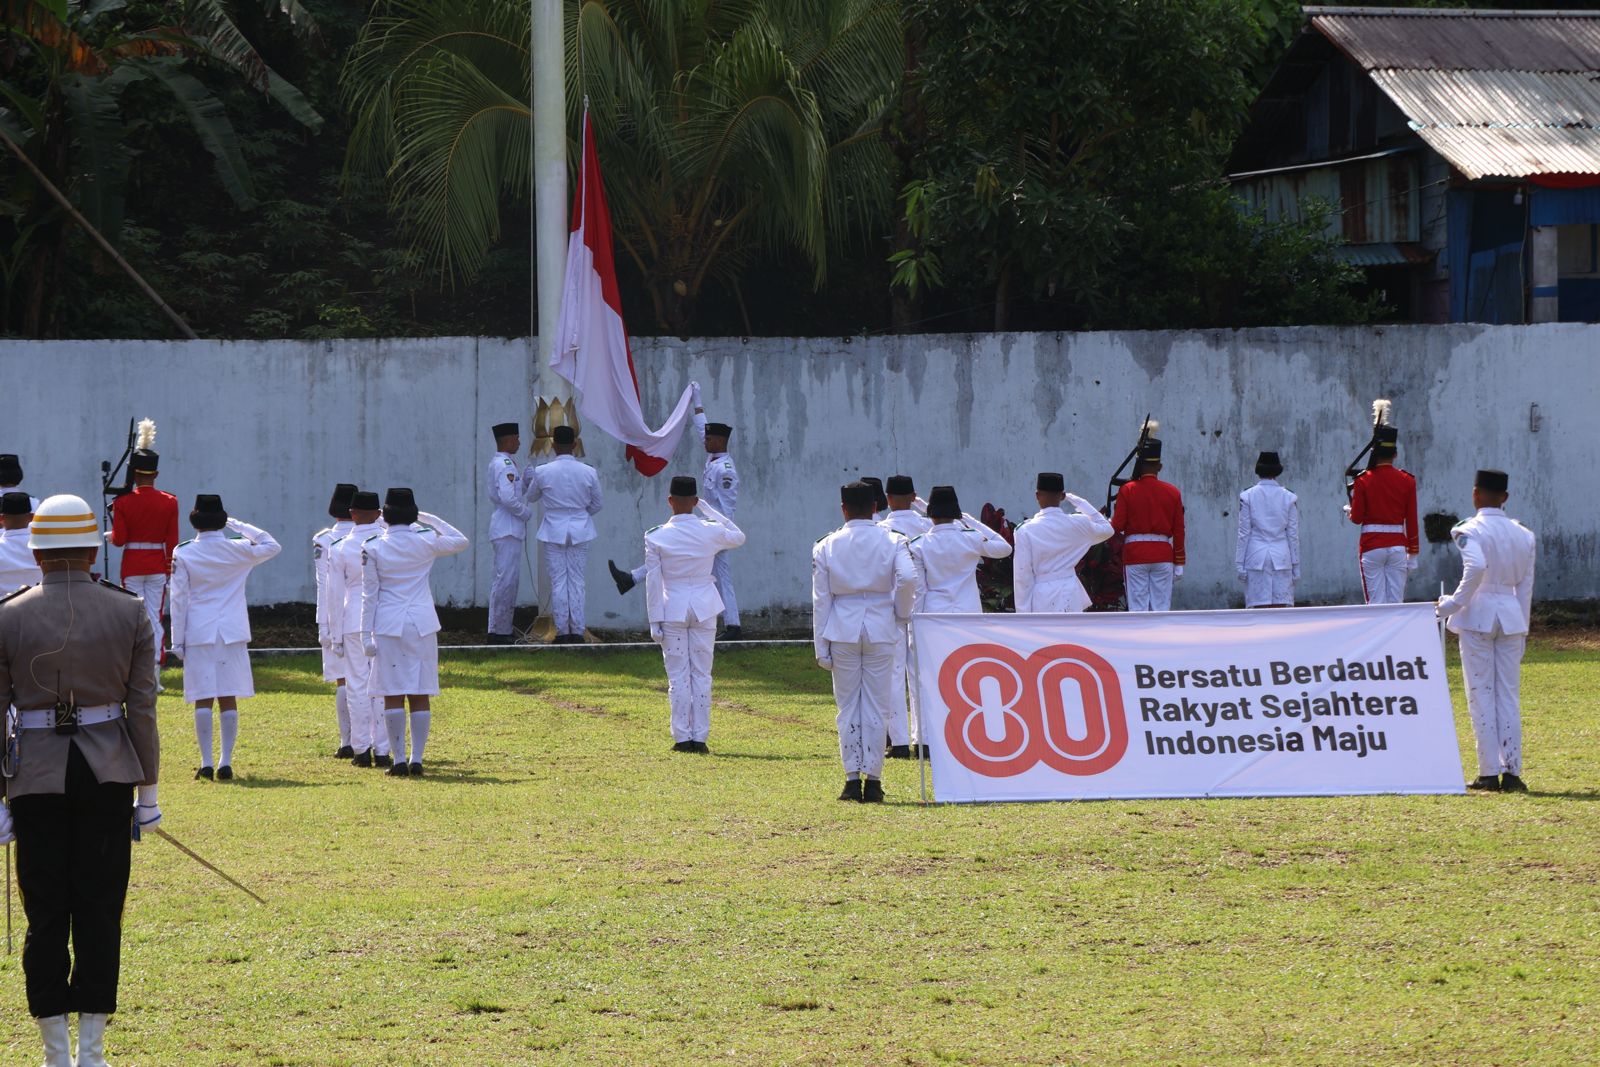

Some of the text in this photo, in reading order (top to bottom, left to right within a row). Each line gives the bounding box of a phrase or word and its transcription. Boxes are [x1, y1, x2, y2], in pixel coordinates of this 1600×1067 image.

[1134, 654, 1429, 689] Bersatu Berdaulat
[1139, 690, 1419, 728] Rakyat Sejahtera
[1144, 724, 1388, 758] Indonesia Maju
